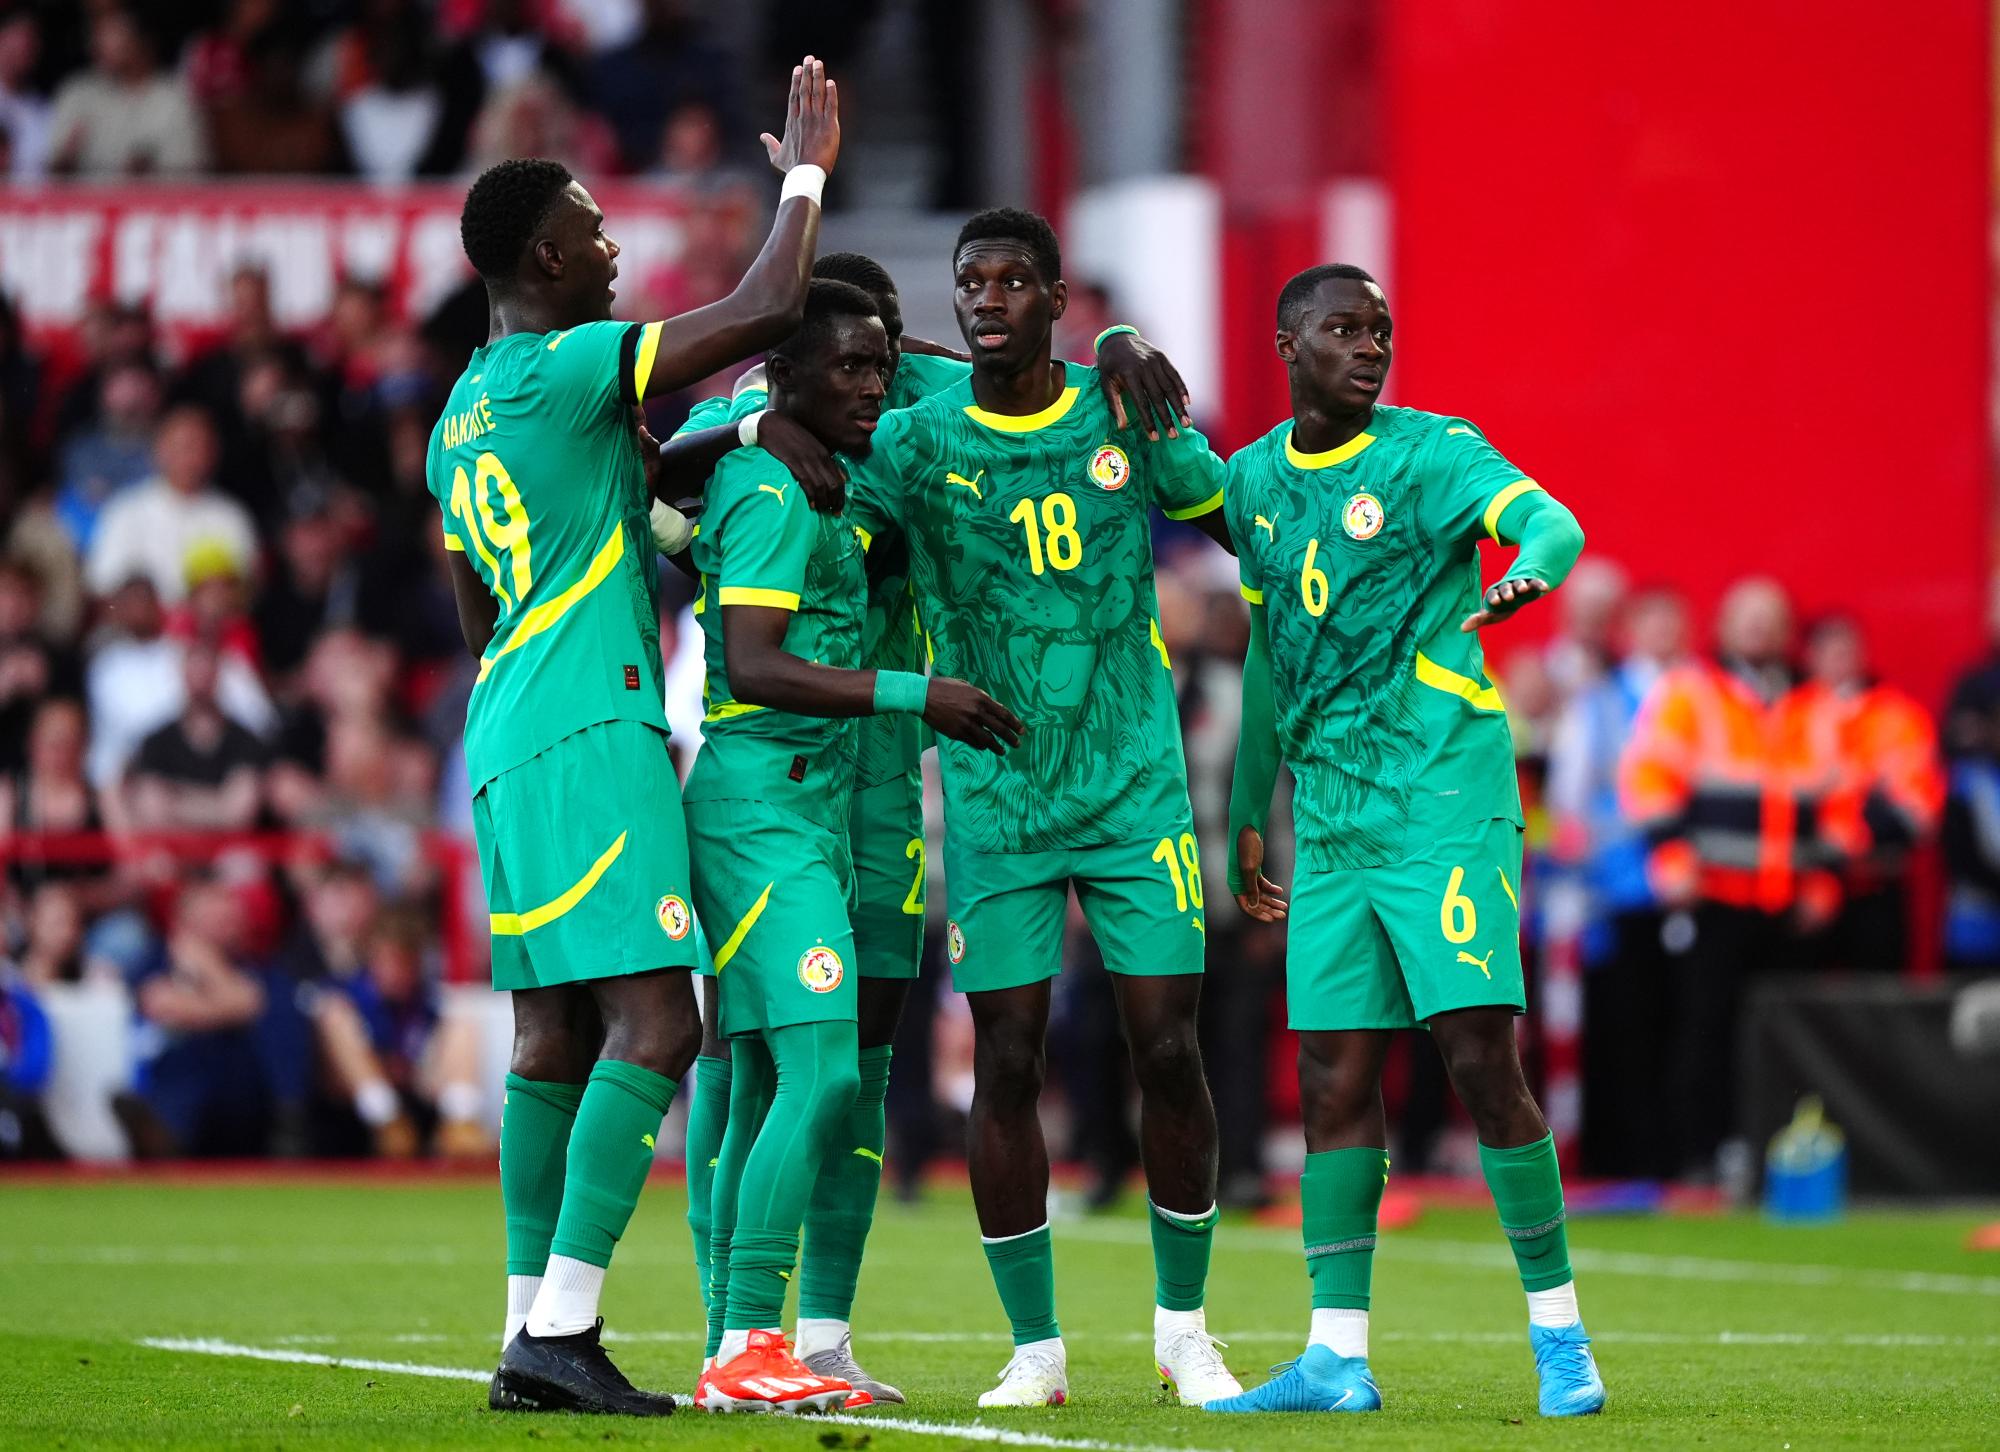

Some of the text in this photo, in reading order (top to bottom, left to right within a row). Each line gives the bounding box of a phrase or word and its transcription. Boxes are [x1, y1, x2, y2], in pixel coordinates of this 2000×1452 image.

[450, 452, 533, 616] 19
[1009, 492, 1083, 574] 18
[1301, 538, 1329, 616] 6
[902, 838, 926, 914] 2
[1151, 832, 1204, 912] 18
[1441, 866, 1477, 943] 6
